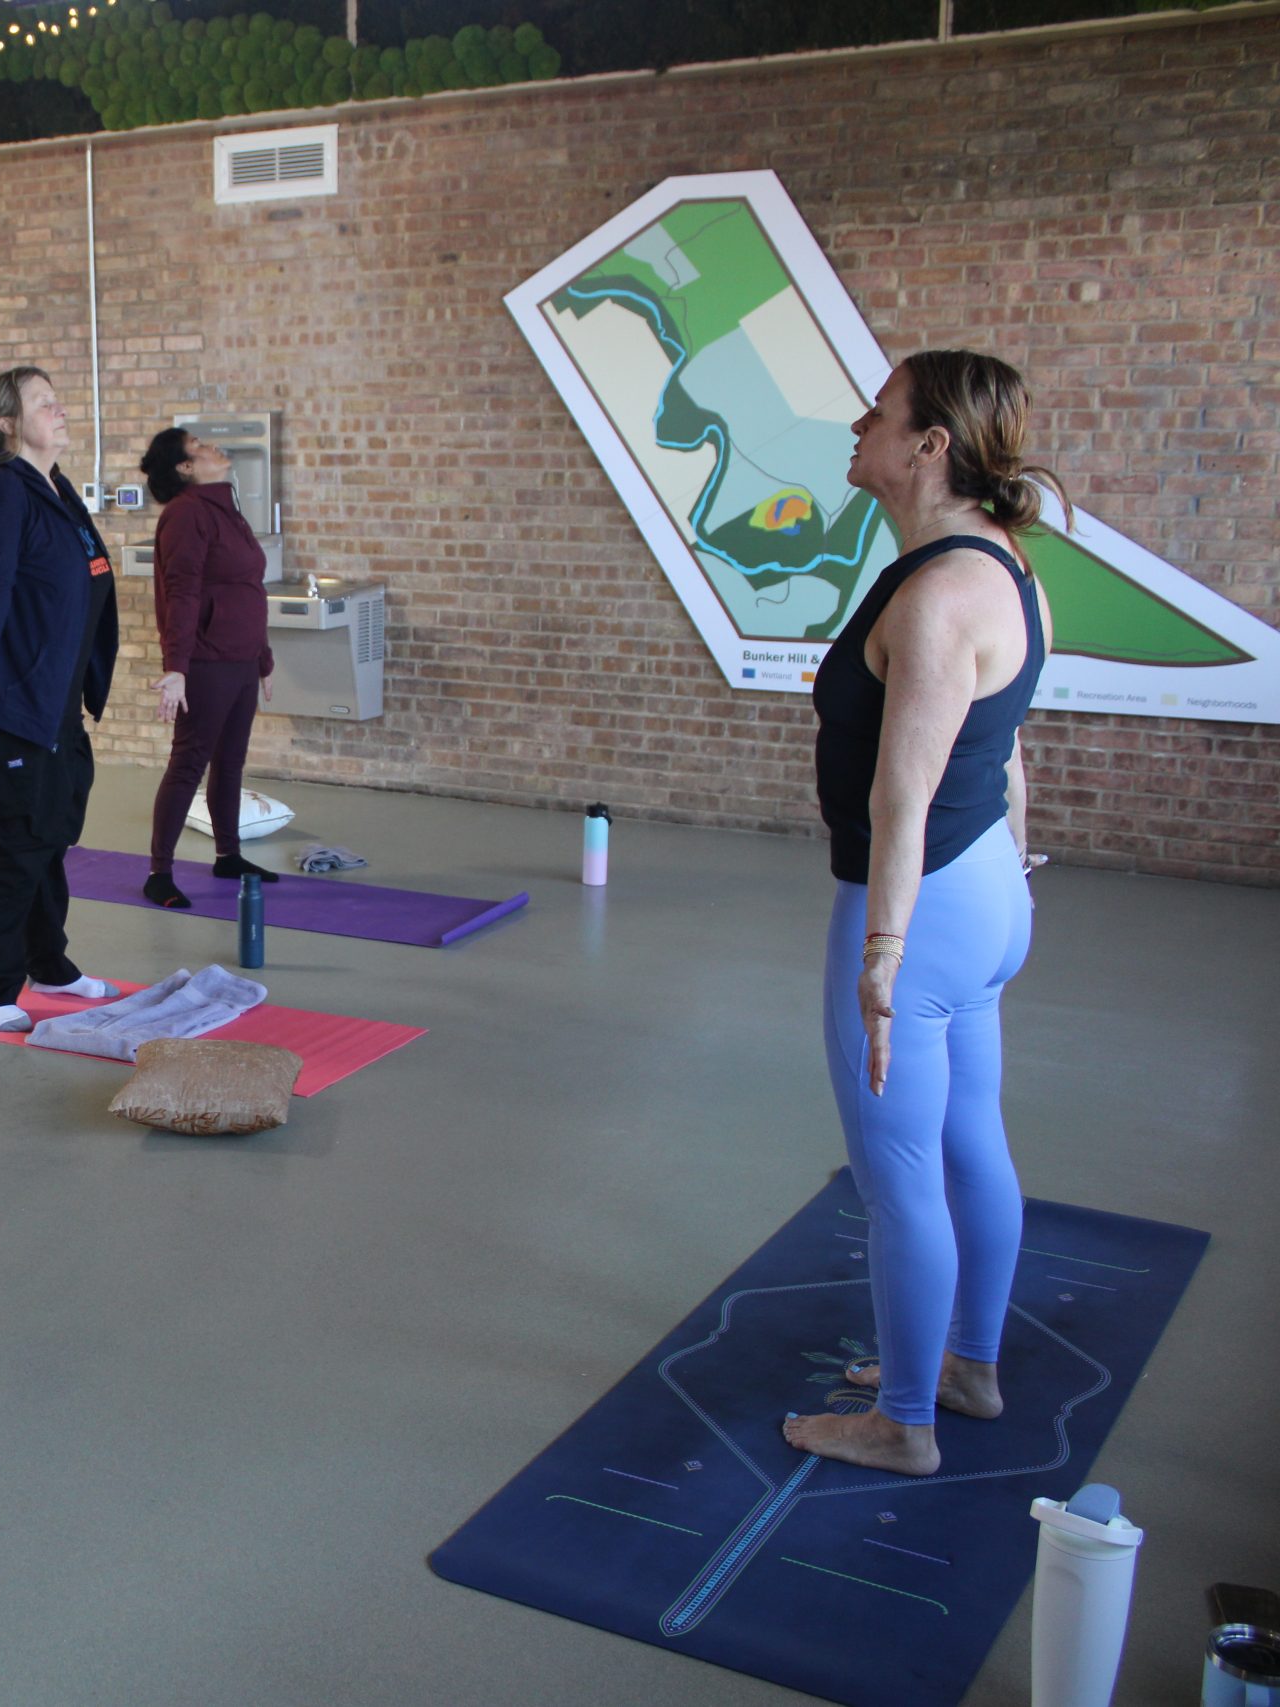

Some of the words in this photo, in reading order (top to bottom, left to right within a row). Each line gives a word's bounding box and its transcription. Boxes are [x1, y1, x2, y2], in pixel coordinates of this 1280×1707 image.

[743, 650, 784, 662] Bunker
[787, 653, 807, 664] Hill
[811, 654, 820, 665] &
[761, 671, 792, 680] Wetland
[1077, 690, 1124, 701] Recreation
[1126, 693, 1147, 703] Area
